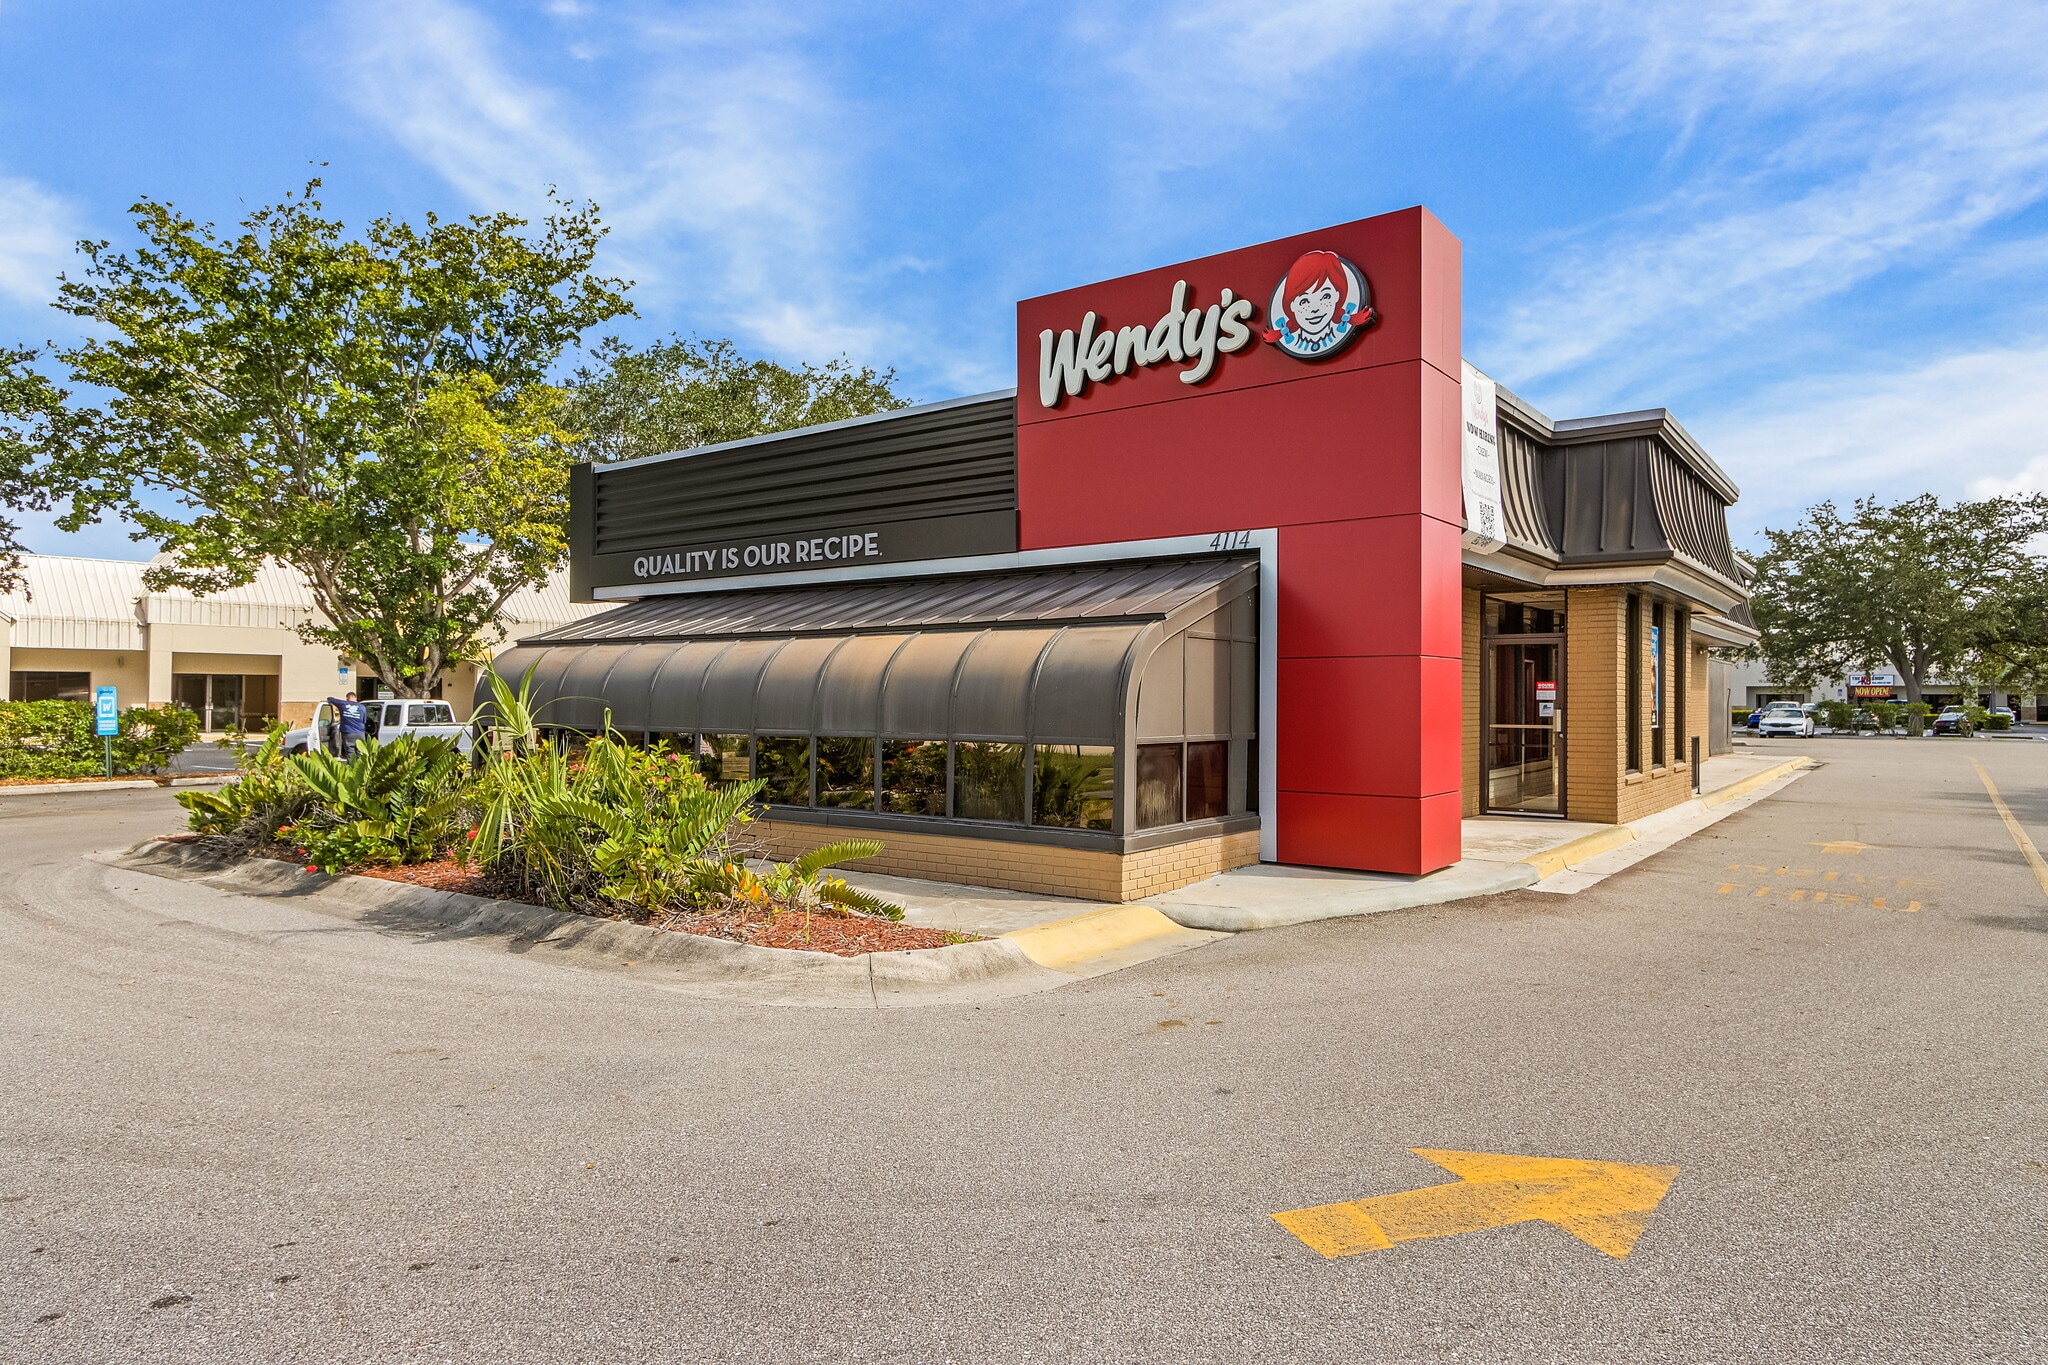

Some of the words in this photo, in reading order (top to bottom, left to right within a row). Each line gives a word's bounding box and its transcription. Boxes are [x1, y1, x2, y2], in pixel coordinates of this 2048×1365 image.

[1038, 279, 1254, 408] Wendy's
[1209, 529, 1251, 551] 4114
[633, 549, 718, 578] QUALITY
[721, 547, 739, 569] IS
[743, 542, 791, 568] OUR
[1855, 687, 1870, 695] NOW
